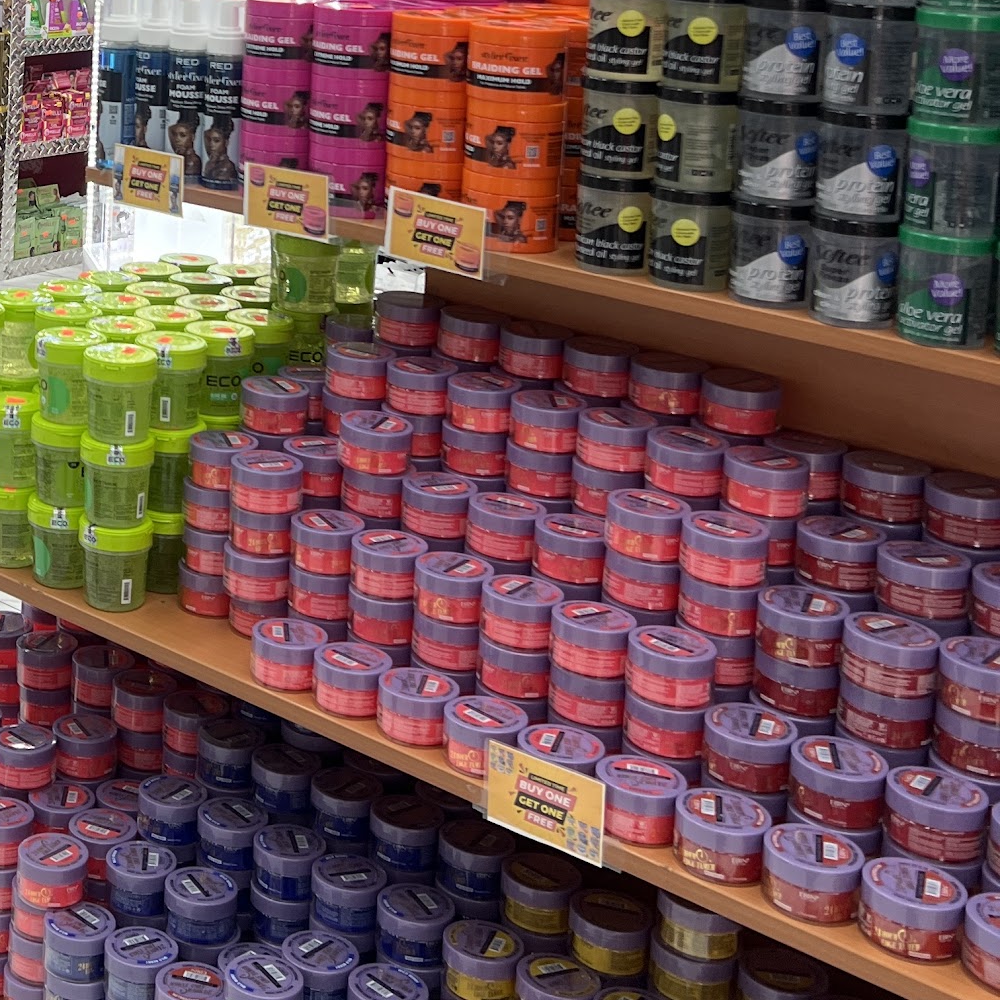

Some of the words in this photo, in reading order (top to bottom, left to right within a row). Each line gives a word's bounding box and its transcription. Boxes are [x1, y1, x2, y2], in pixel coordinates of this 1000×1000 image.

[277, 36, 296, 45] GEL
[793, 31, 812, 41] Best
[345, 45, 364, 53] GEL
[596, 43, 619, 54] black
[620, 47, 647, 55] castor
[788, 39, 816, 50] value!
[840, 39, 858, 48] Best
[175, 57, 200, 66] RED
[420, 53, 440, 62] GEL
[597, 53, 607, 63] oil
[690, 55, 719, 64] castor
[943, 55, 970, 64] More
[209, 61, 234, 70] RED
[471, 61, 521, 75] BRAIDING
[523, 67, 543, 76] GEL
[756, 60, 815, 75] protein
[169, 90, 204, 100] MOUSSE
[935, 86, 972, 100] vera
[204, 94, 239, 104] MOUSSE
[262, 101, 279, 110] GEL
[953, 99, 972, 112] gel
[333, 112, 352, 123] GEL
[593, 141, 615, 152] black
[616, 144, 643, 153] castor
[592, 150, 603, 160] oil
[874, 150, 892, 160] Best
[131, 168, 146, 177] BUY
[148, 170, 163, 181] ONE
[836, 179, 895, 195] protein
[269, 188, 286, 199] BUY
[287, 191, 307, 202] ONE
[284, 203, 301, 213] ONE
[913, 207, 930, 218] gel
[275, 212, 295, 223] FREE
[416, 218, 436, 230] BUY
[437, 223, 459, 236] ONE
[415, 231, 433, 242] GET
[434, 236, 453, 247] ONE
[595, 238, 619, 249] black
[422, 245, 444, 257] FREE
[595, 250, 607, 260] oil
[934, 280, 960, 289] More
[927, 311, 964, 324] vera
[944, 324, 964, 337] gel
[289, 351, 323, 363] ECO
[206, 375, 241, 387] ECO
[3, 419, 20, 427] ECO
[107, 456, 125, 464] ECO
[52, 519, 68, 527] ECO
[519, 780, 543, 796] BUY
[545, 790, 572, 808] ONE
[518, 795, 540, 810] GET
[541, 804, 564, 820] ONE
[527, 812, 554, 830] FREE
